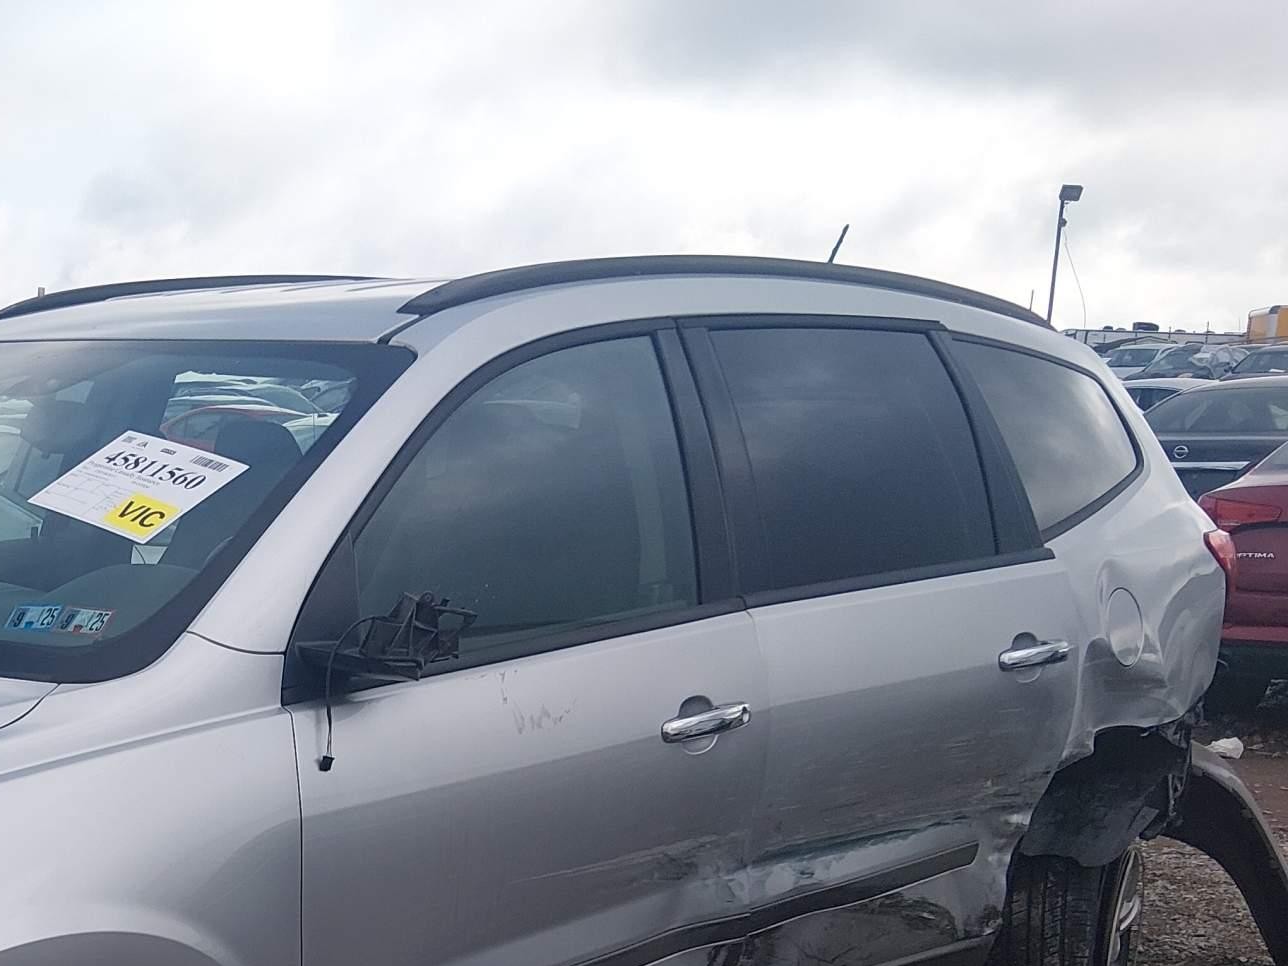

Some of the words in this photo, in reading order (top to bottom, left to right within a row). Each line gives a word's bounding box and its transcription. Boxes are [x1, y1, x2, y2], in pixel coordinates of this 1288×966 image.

[104, 450, 207, 490] 45811560
[117, 500, 166, 529] VIC
[1237, 551, 1276, 559] PTIMA
